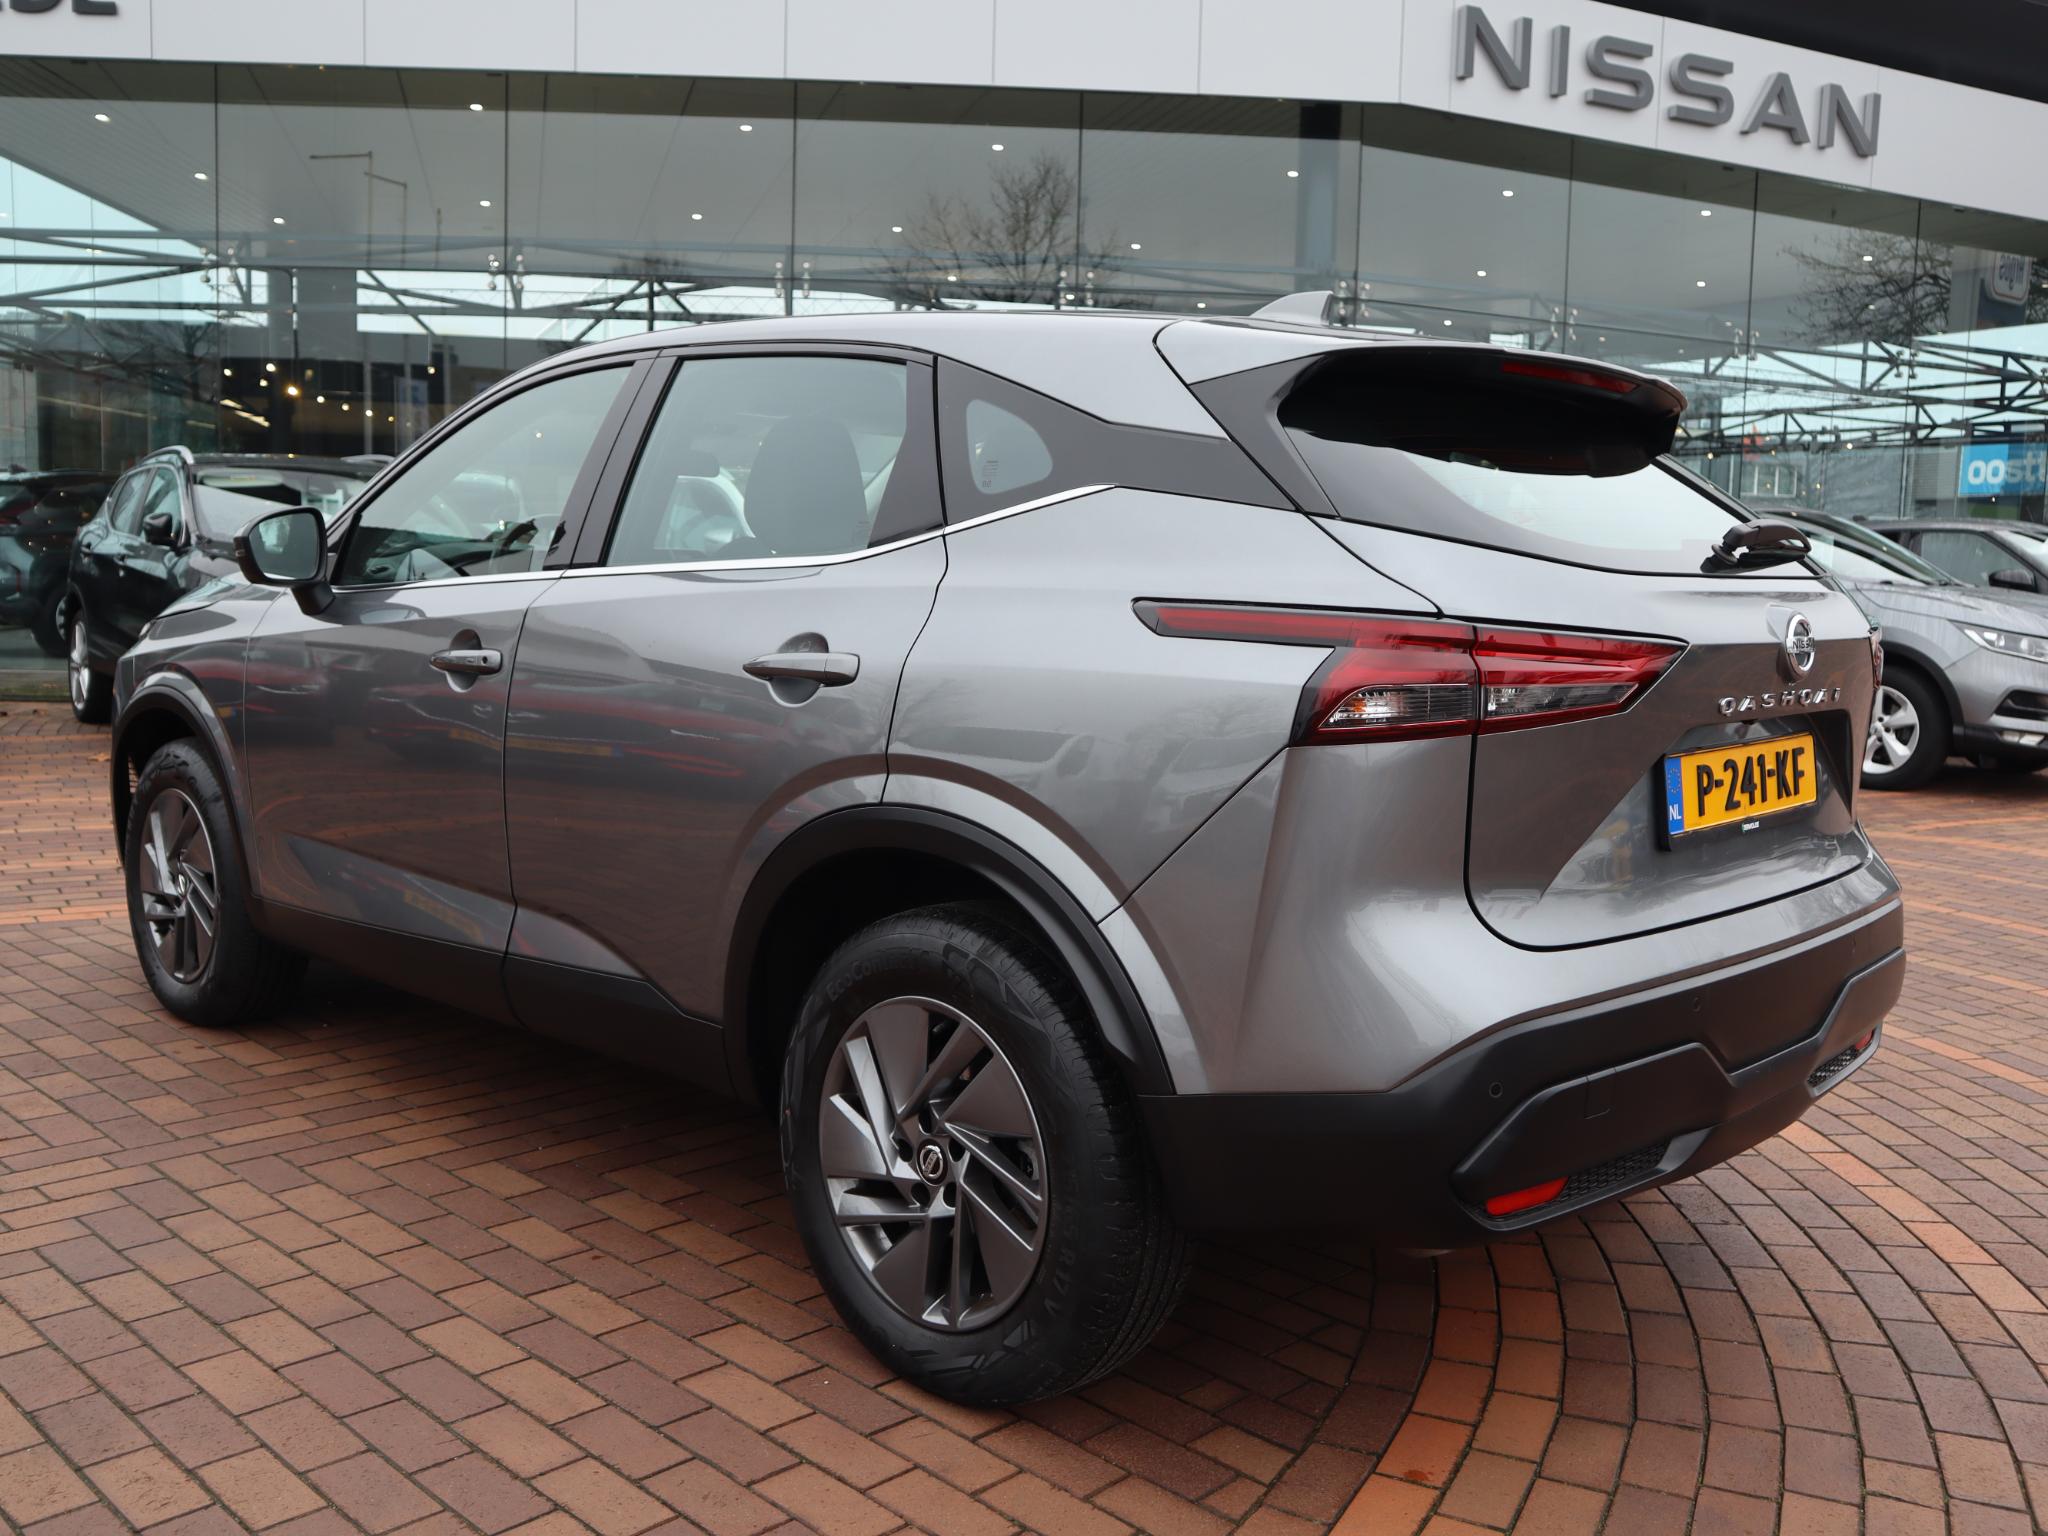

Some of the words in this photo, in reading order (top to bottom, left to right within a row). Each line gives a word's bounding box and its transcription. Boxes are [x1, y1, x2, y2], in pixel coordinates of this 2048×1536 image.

[1457, 5, 1881, 157] NISSAN
[1718, 687, 1841, 716] QASHQAI
[1696, 746, 1805, 817] P-241-KF
[1669, 805, 1682, 821] NL
